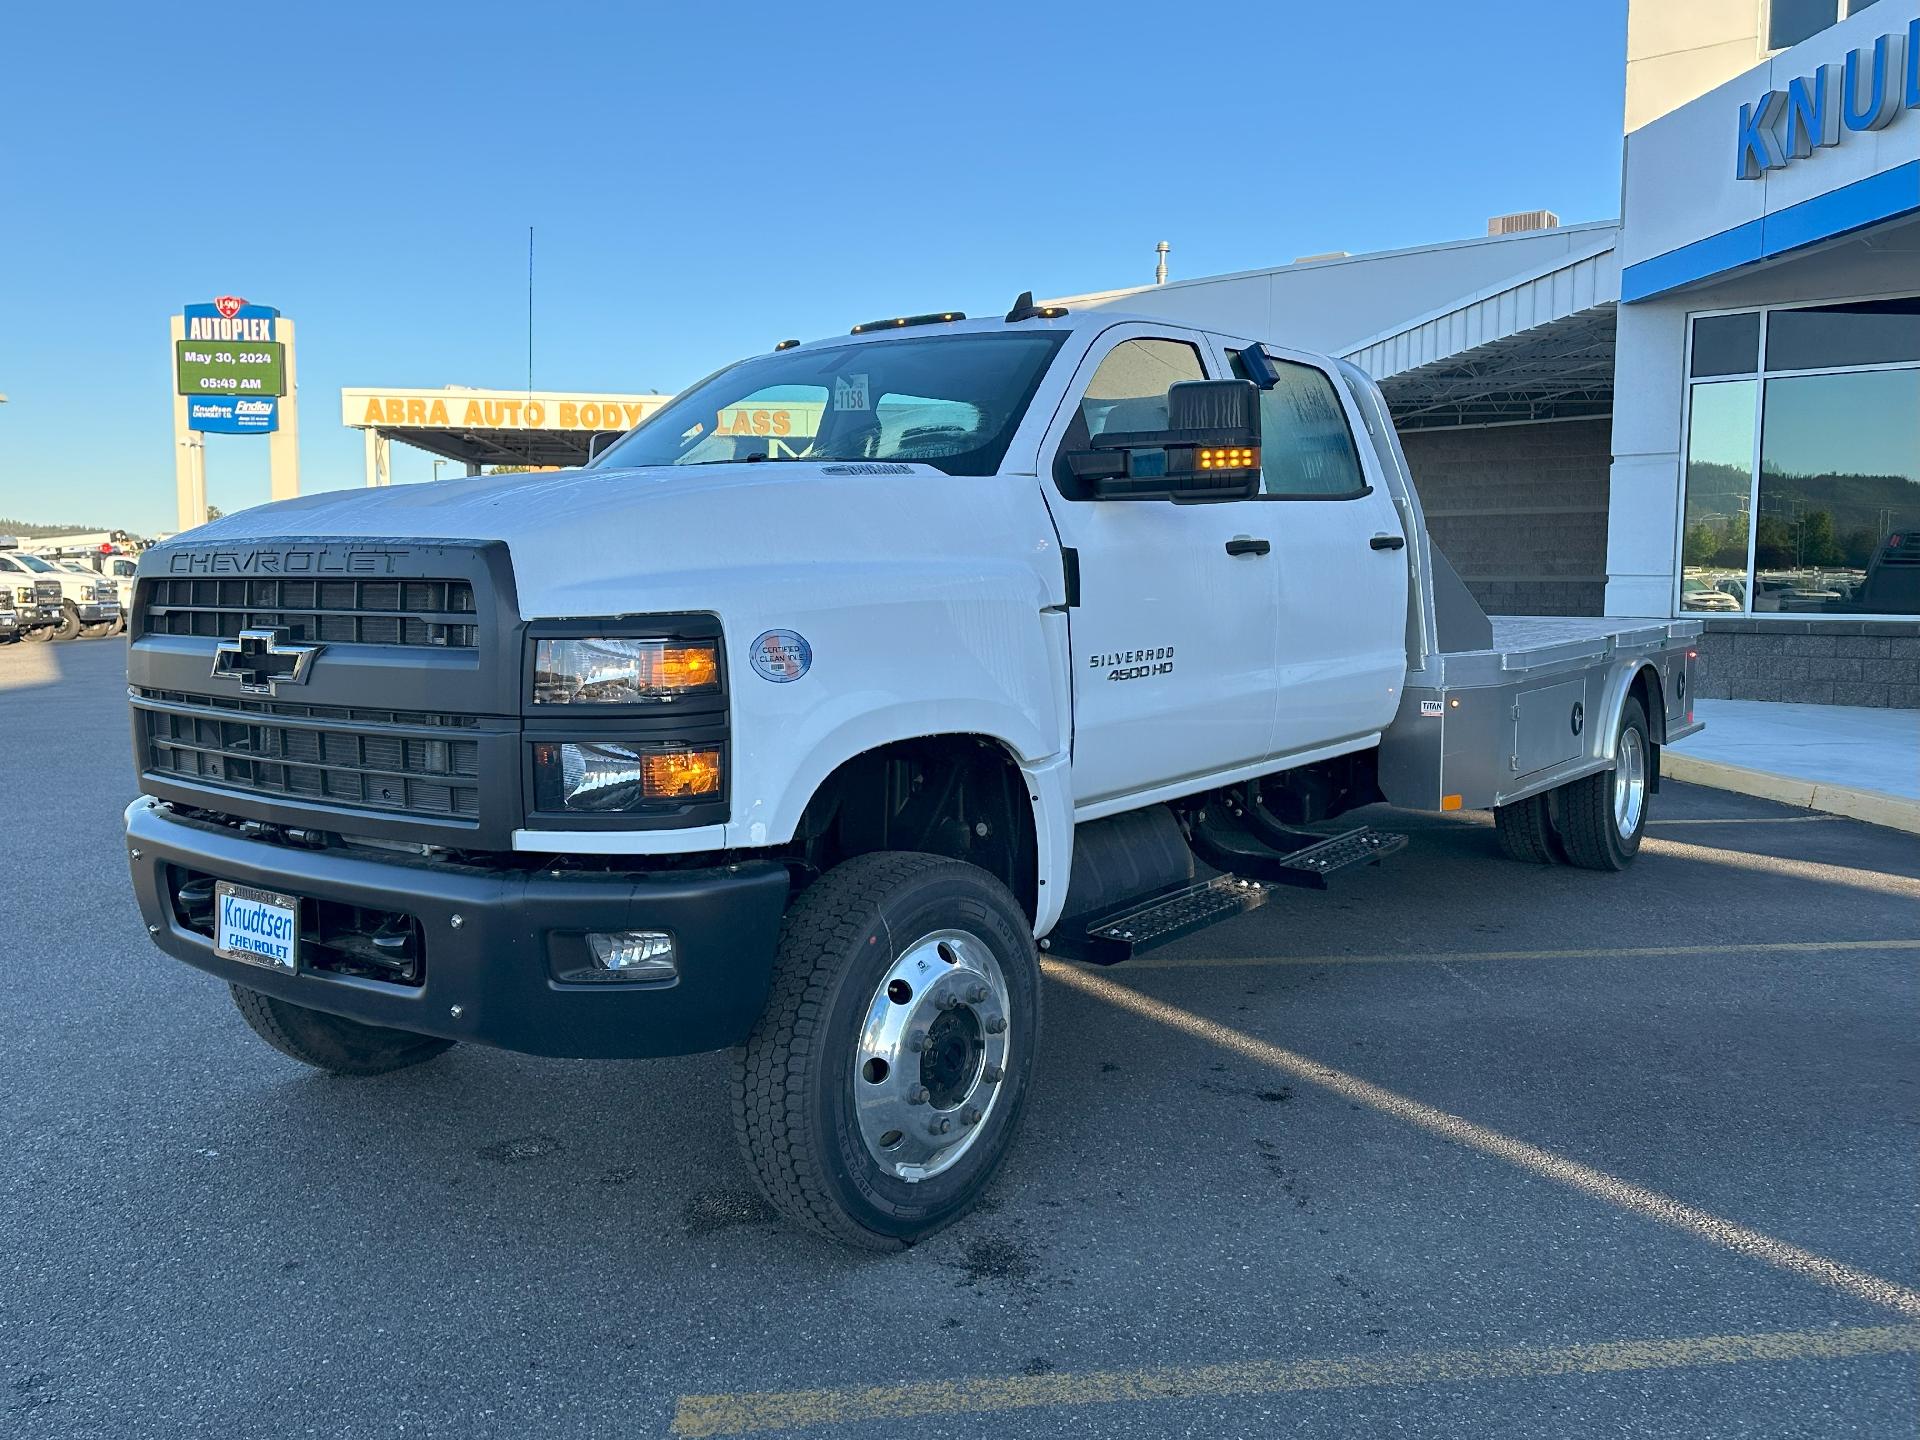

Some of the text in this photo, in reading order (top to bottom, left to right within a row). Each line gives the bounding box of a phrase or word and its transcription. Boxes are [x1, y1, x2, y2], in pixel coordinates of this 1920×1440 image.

[219, 299, 238, 310] I-90
[190, 318, 270, 341] AUTOPLEX
[184, 352, 272, 364] May 30, 2024
[200, 378, 261, 389] 05:49 AM
[839, 390, 863, 409] 1158
[364, 398, 791, 436] ABRA AUTO BODY LASS
[170, 551, 410, 573] CHEVROLET
[759, 655, 785, 663] CLEAN
[762, 645, 800, 654] CERTIFIED
[1089, 646, 1174, 668] SILVERADO
[1107, 662, 1173, 681] 4500 HD
[224, 896, 292, 941] Knudtsen
[229, 933, 288, 959] CHEVROLET
